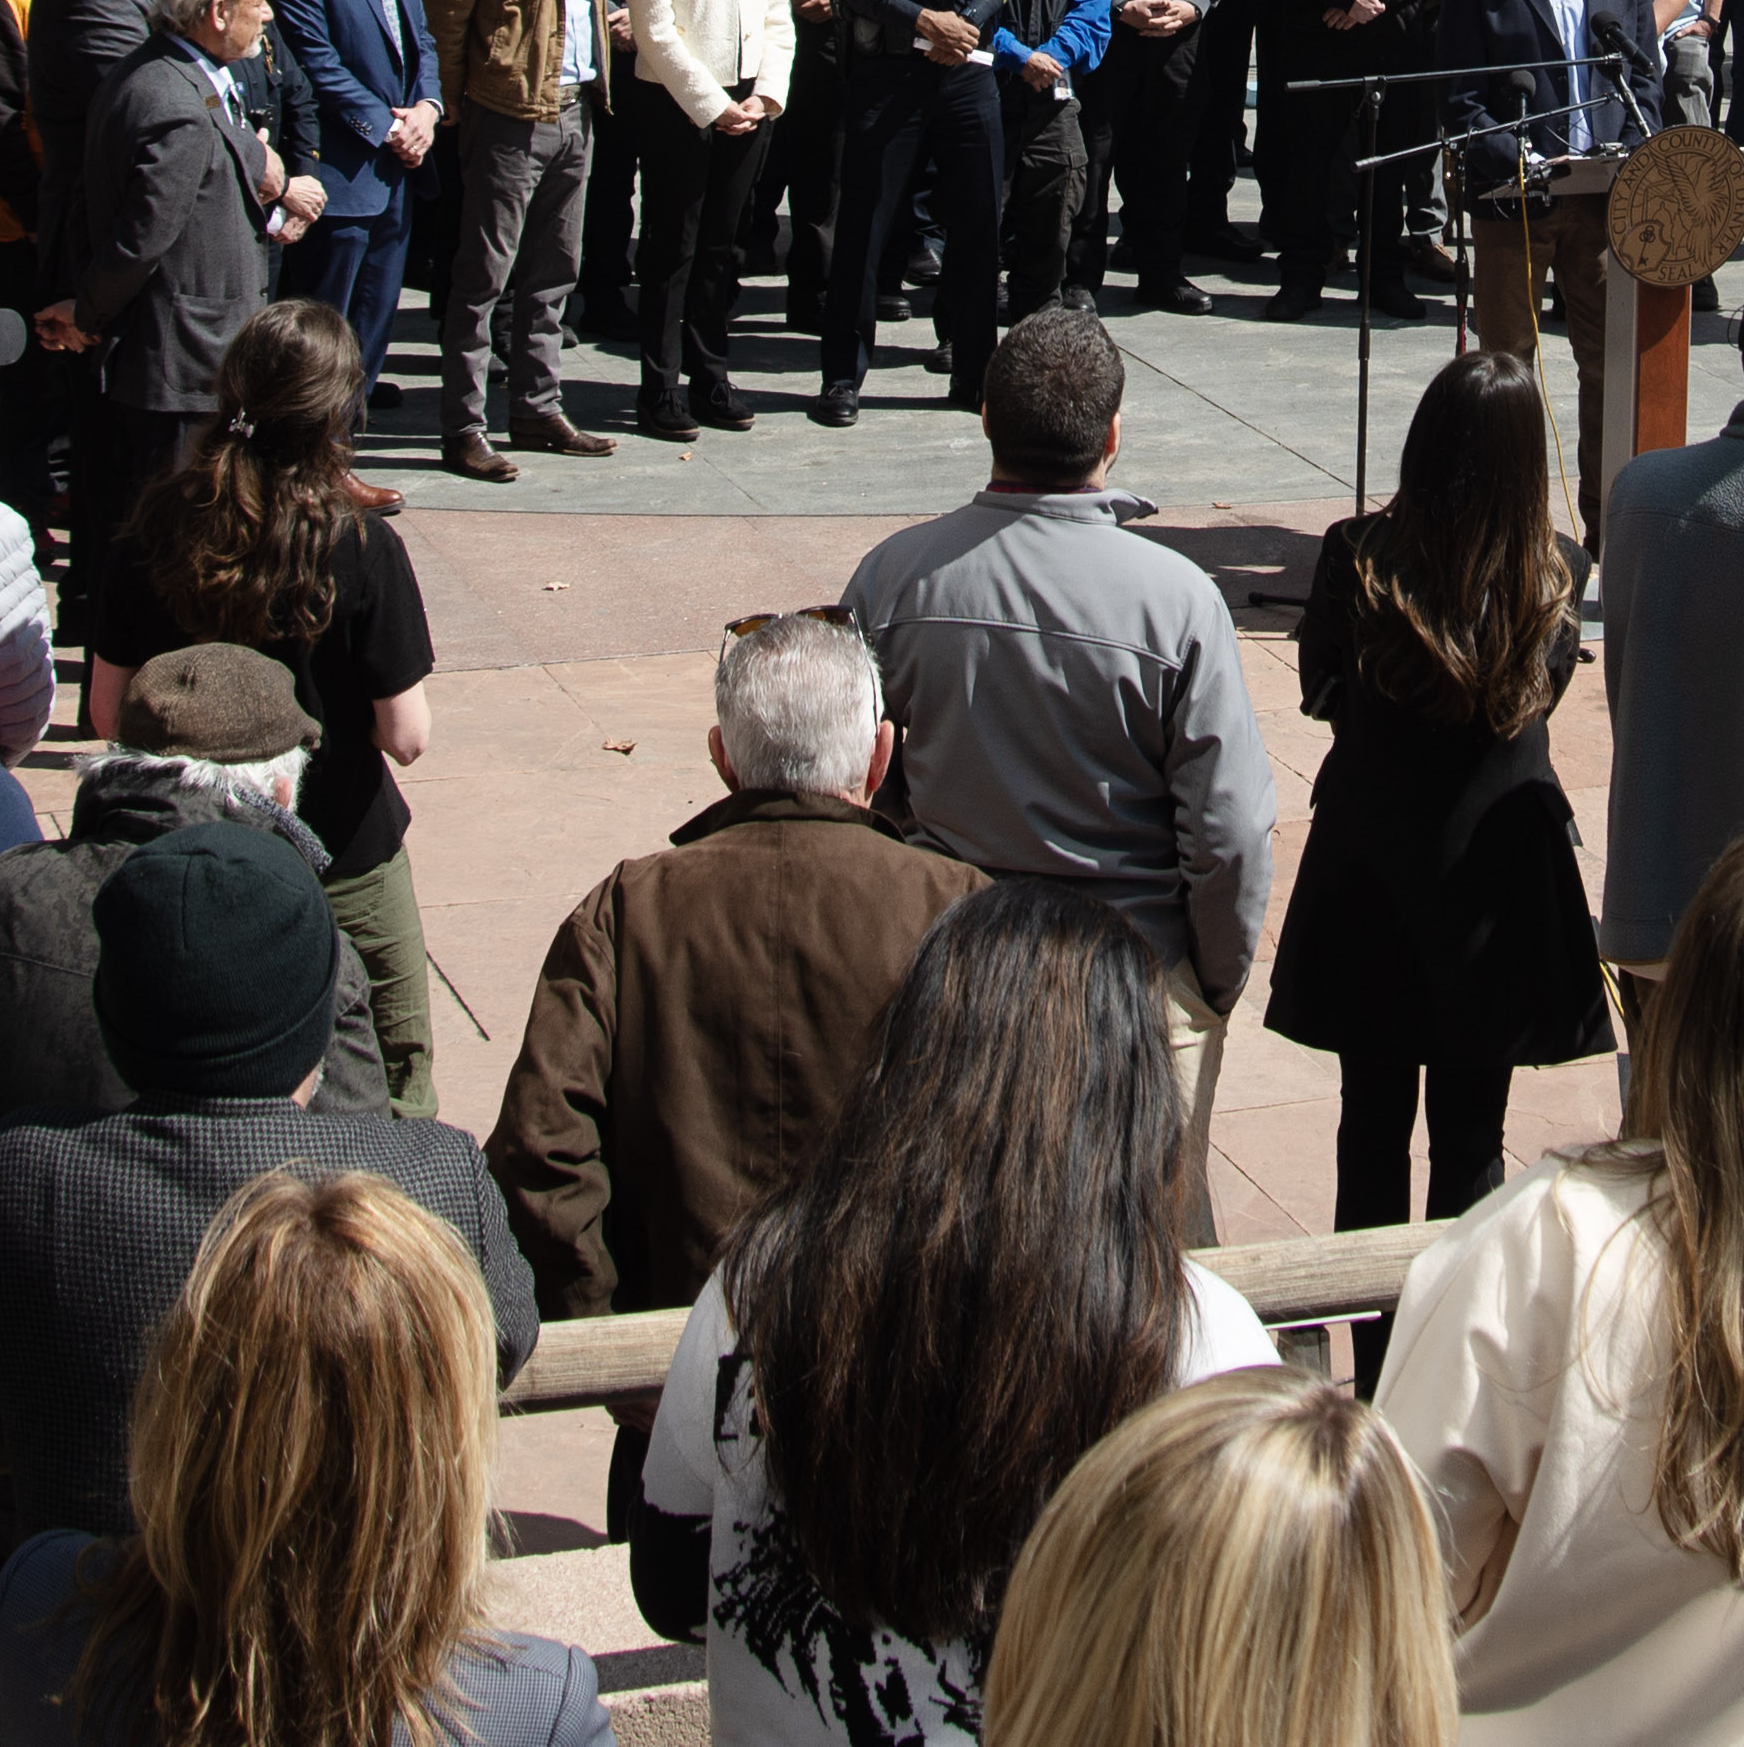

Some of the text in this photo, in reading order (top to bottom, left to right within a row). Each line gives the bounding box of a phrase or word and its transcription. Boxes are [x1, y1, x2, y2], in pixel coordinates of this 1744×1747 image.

[1613, 192, 1628, 235] CITY
[1622, 153, 1650, 190] AND
[1658, 133, 1721, 151] COUNTY
[1659, 264, 1696, 280] SEAL
